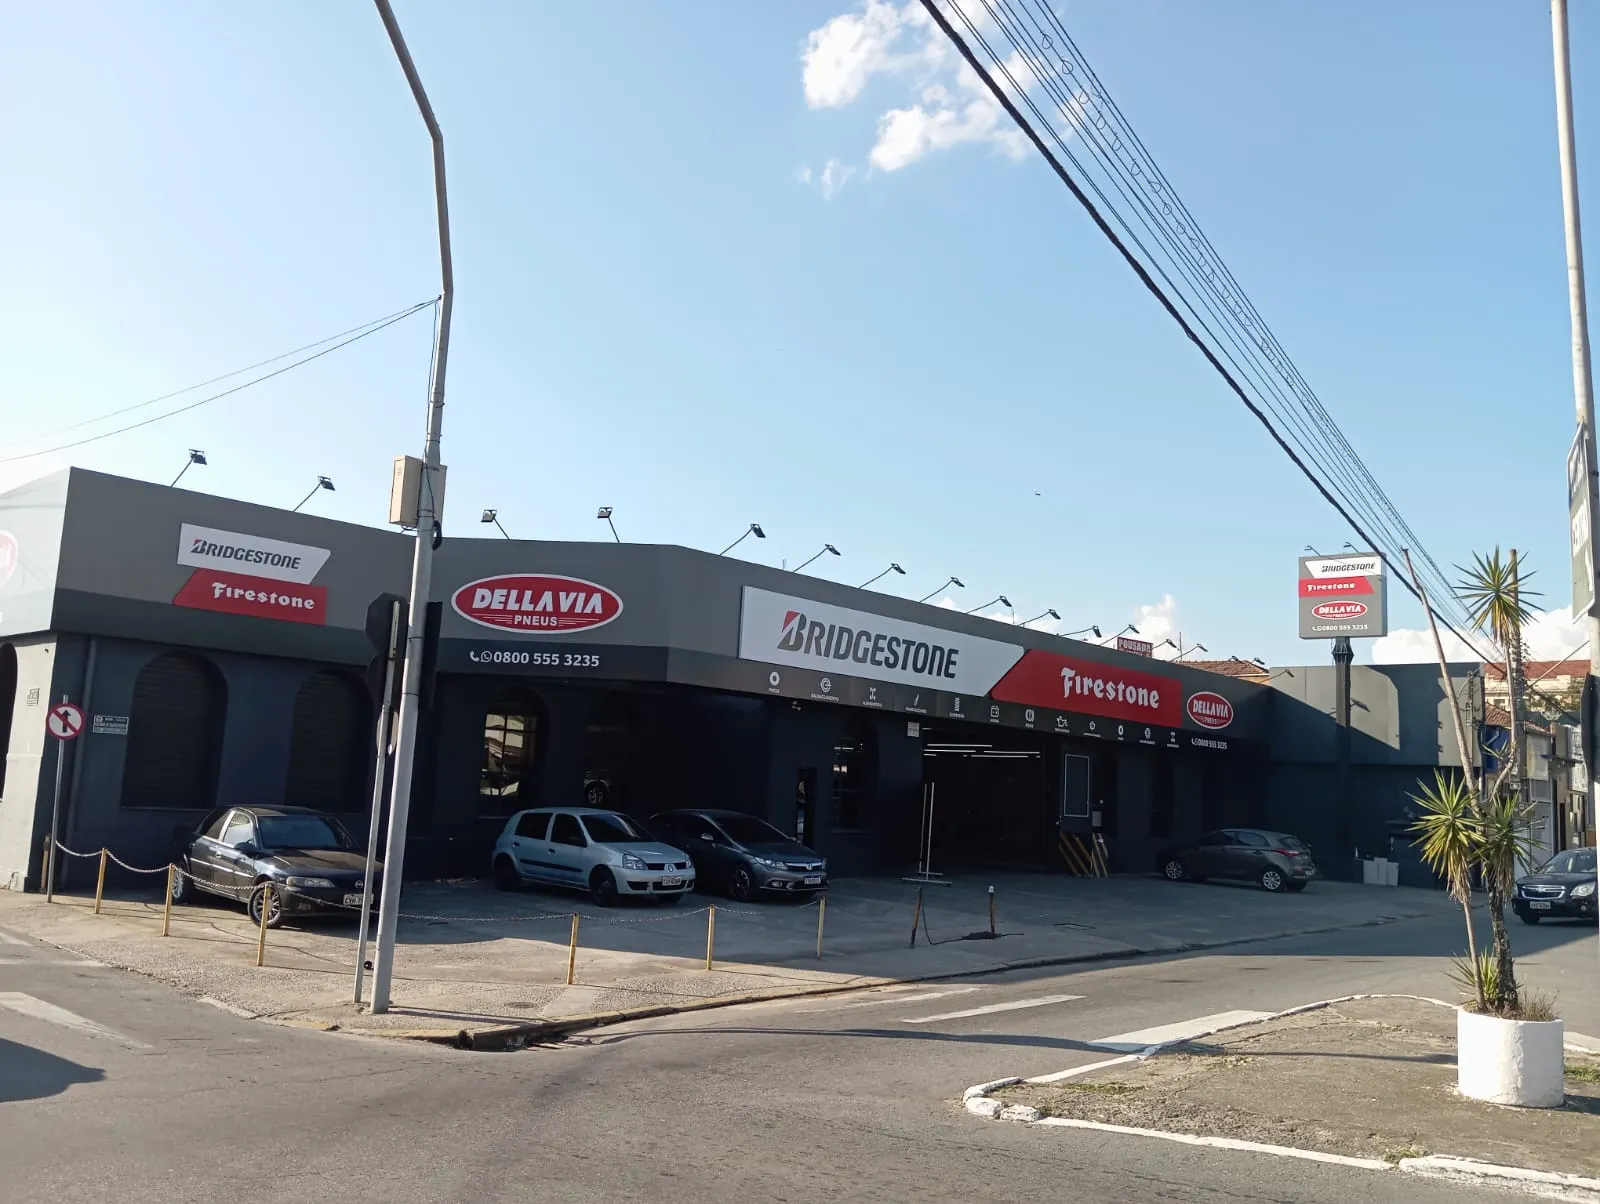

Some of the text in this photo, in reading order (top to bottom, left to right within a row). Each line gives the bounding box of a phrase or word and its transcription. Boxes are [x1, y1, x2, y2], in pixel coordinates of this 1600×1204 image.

[191, 539, 302, 569] BRIDGESTONE
[1321, 562, 1376, 573] BRIDGESTONE
[212, 582, 315, 609] Firestone
[514, 615, 559, 626] PNEUS
[777, 610, 960, 679] BRIDGESTONE
[1118, 639, 1152, 653] POUSADA
[493, 651, 600, 667] 0800 555 3235
[1060, 667, 1160, 709] Firestone
